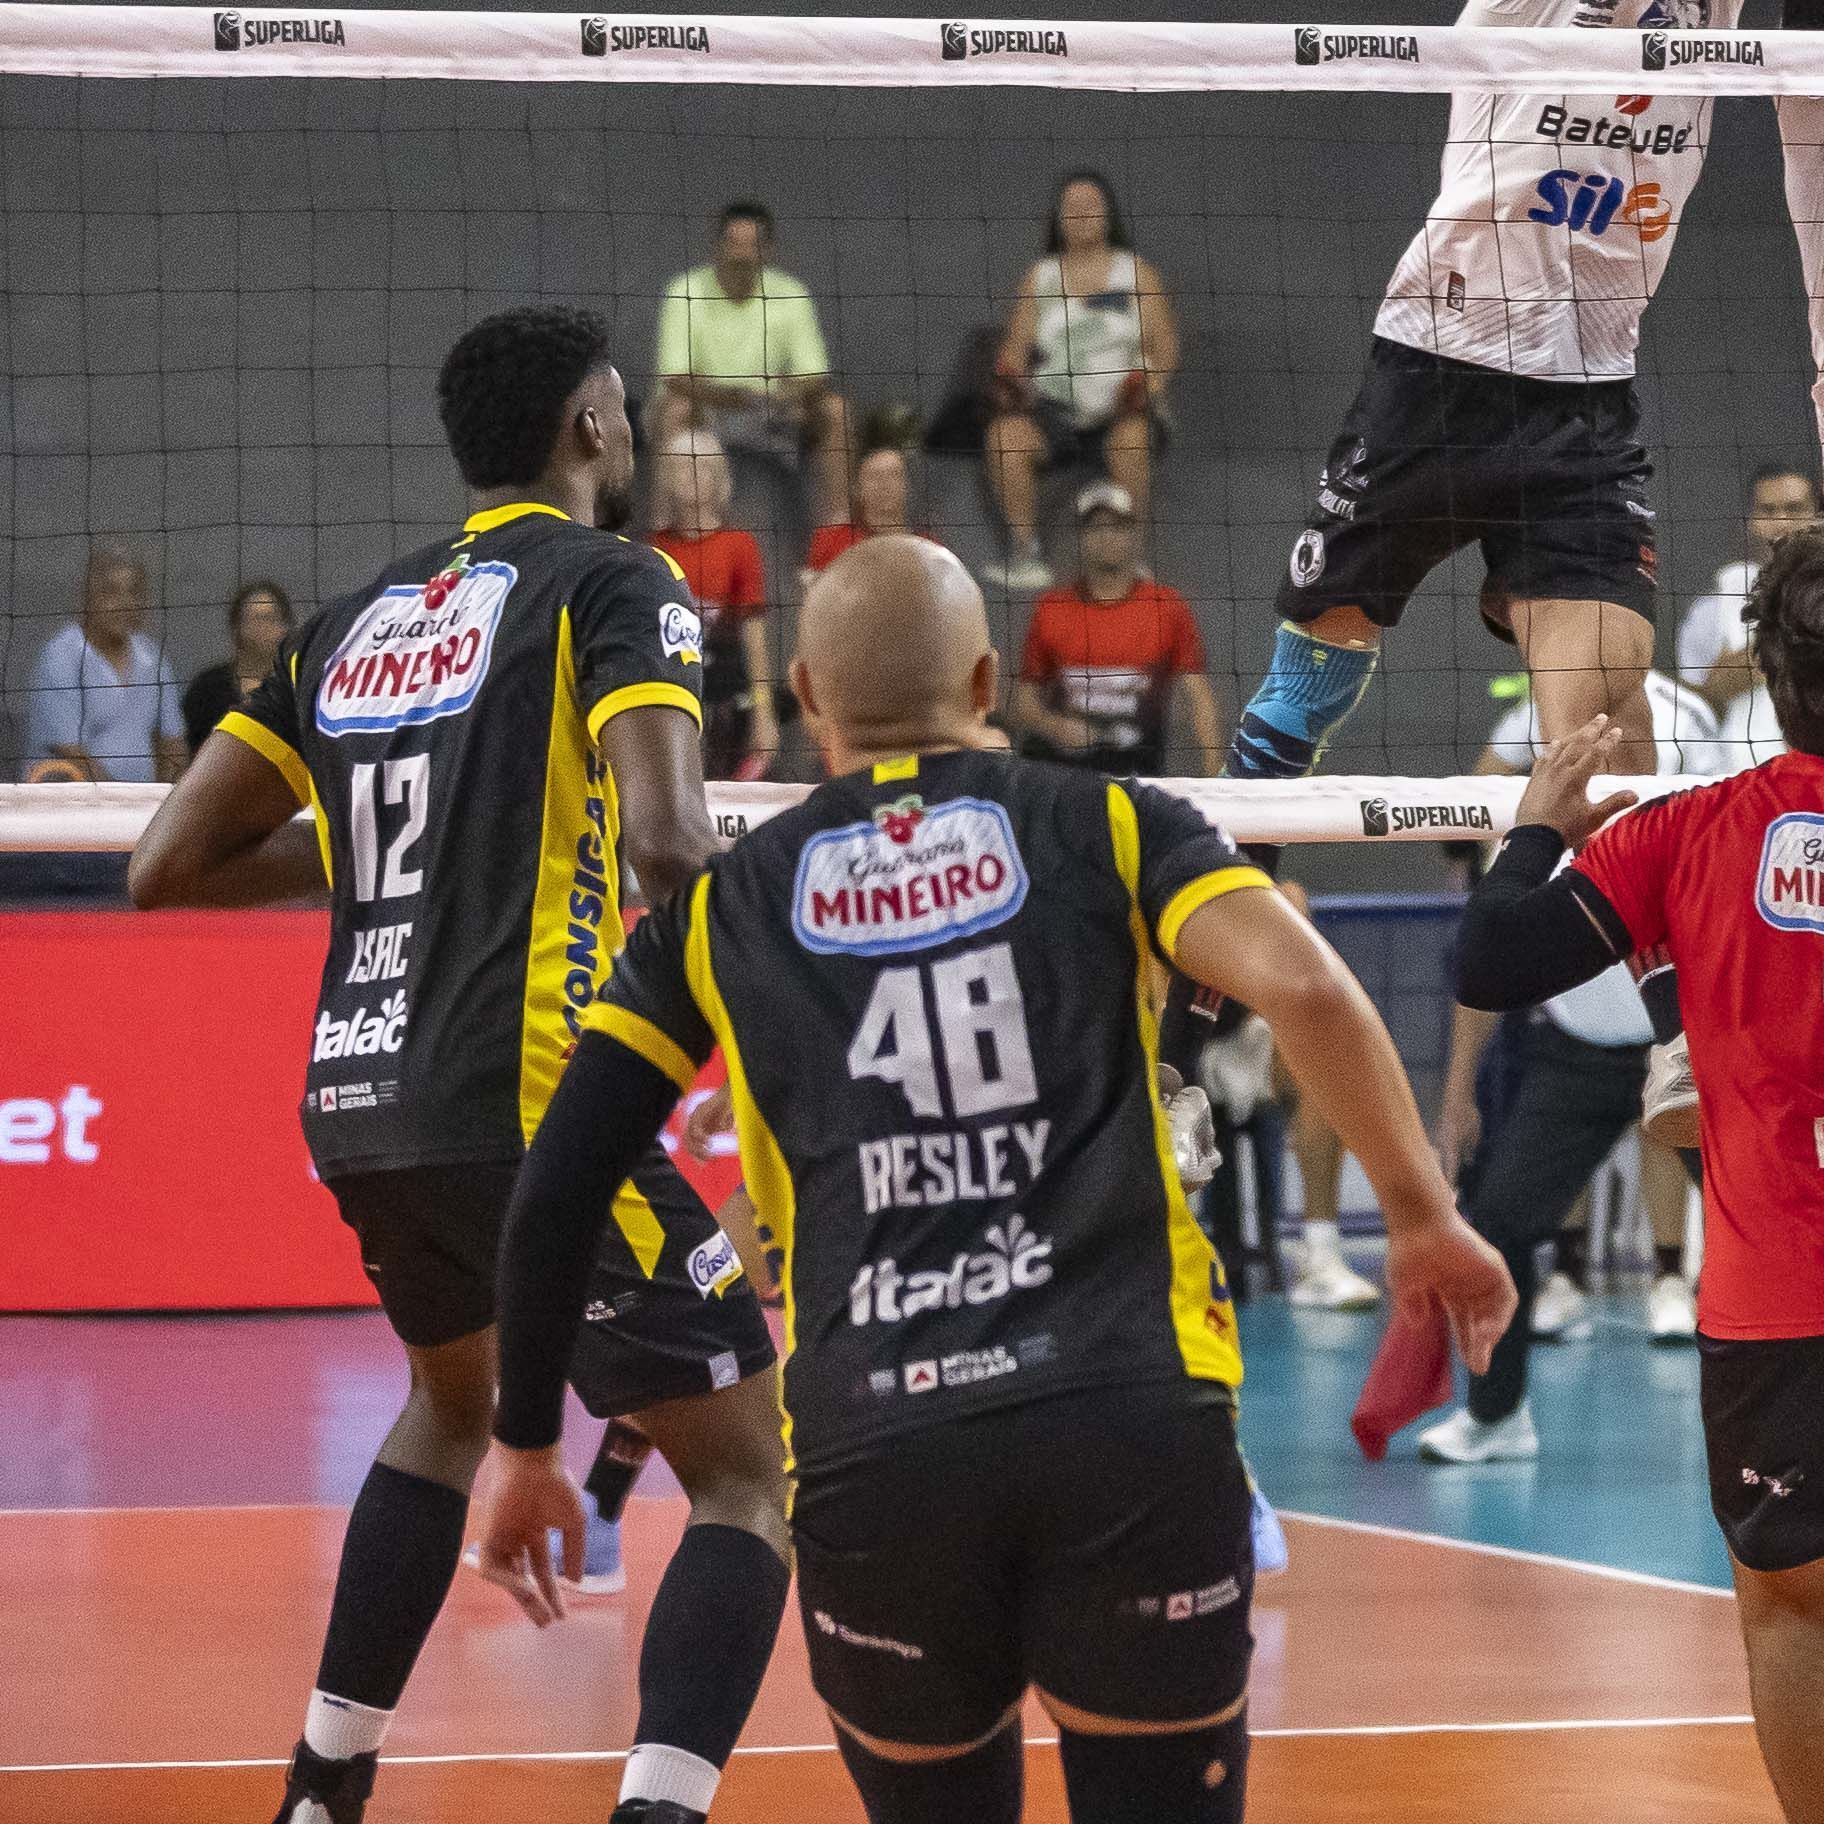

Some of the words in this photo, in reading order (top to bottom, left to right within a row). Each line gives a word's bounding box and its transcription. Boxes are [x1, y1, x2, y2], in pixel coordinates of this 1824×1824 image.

[244, 20, 346, 48] SUPERLIGA
[611, 25, 711, 55] SUPERLIGA
[970, 29, 1070, 59] SUPERLIGA
[1323, 34, 1421, 64] SUPERLIGA
[1669, 39, 1765, 68] SUPERLIGA
[1527, 169, 1625, 236] Sil
[351, 753, 430, 902] 12
[1391, 805, 1494, 832] SUPERLIGA
[812, 853, 1007, 928] MINEIRO
[345, 922, 413, 984] ISAC
[313, 1008, 408, 1063] talac
[848, 943, 1038, 1118] 48
[0, 1083, 102, 1164] et
[858, 1119, 1051, 1215] RESLEY
[849, 1238, 1054, 1326] Italac
